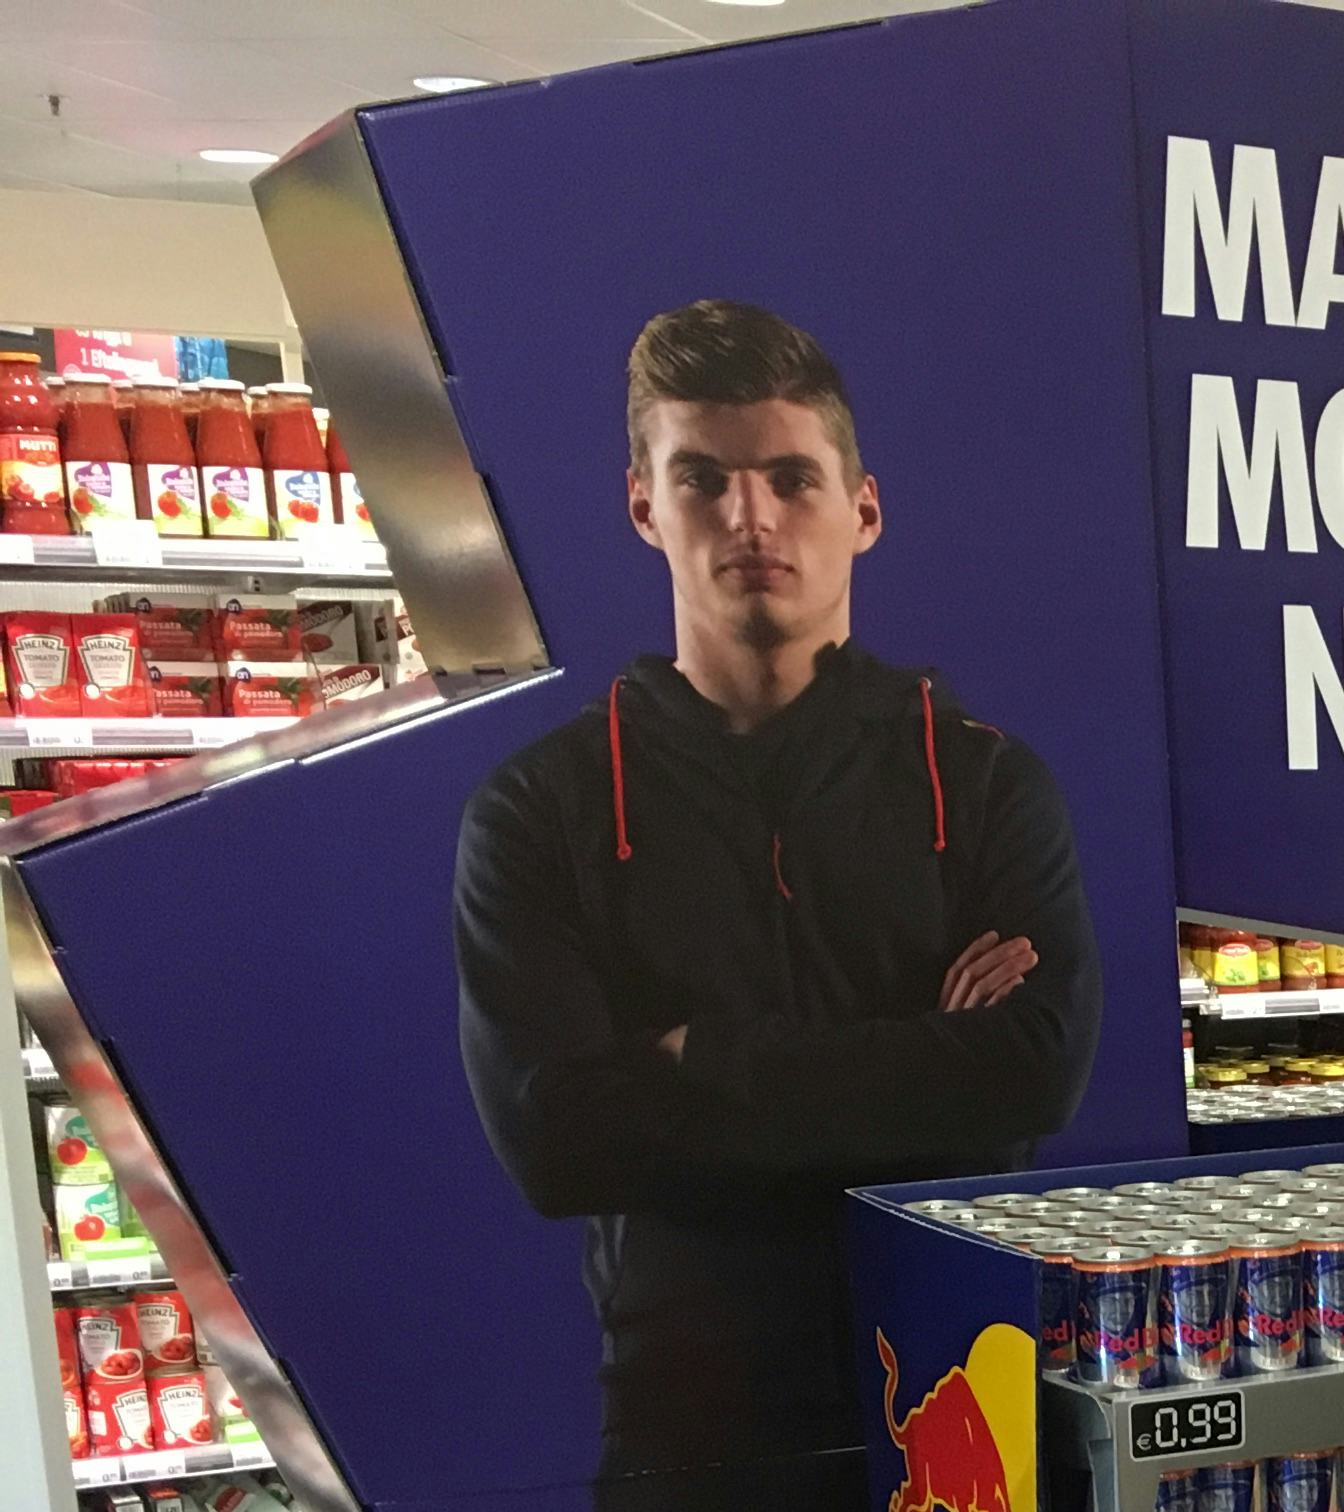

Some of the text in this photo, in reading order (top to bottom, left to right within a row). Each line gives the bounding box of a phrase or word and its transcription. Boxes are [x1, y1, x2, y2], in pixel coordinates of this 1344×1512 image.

[229, 620, 271, 632] Passata
[24, 639, 57, 650] HEINZ
[89, 639, 122, 650] HEINZ
[24, 654, 60, 663] TOMATO
[89, 654, 125, 663] TOMATO
[238, 688, 281, 700] Passata
[1179, 1323, 1222, 1345] Red
[1094, 1329, 1139, 1353] Red
